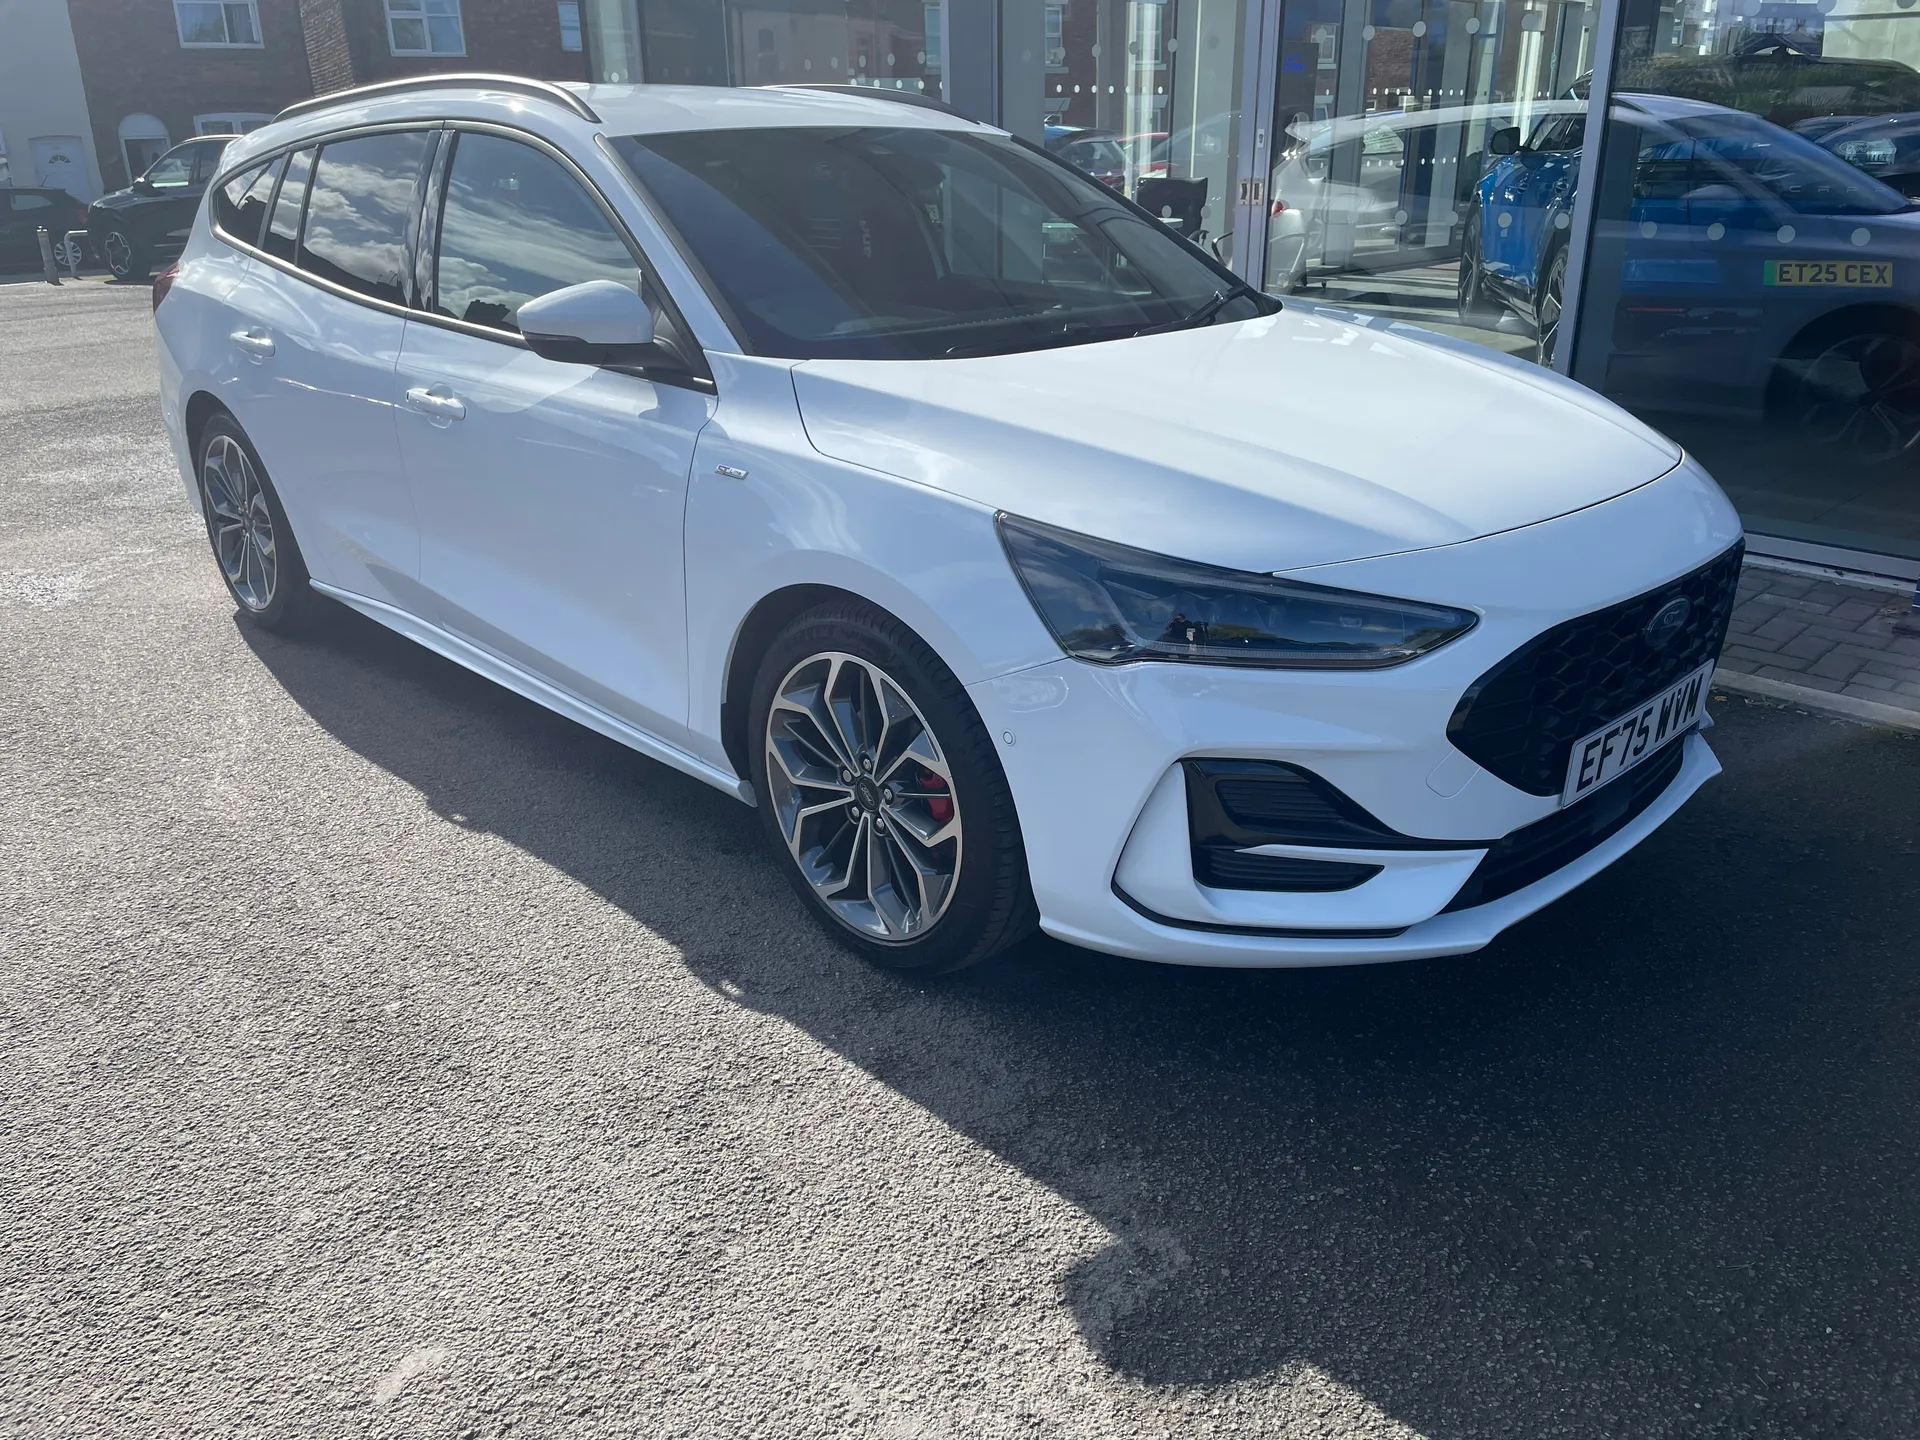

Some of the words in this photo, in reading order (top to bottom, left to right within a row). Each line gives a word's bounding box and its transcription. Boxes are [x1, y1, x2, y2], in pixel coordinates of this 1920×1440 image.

[1779, 263, 1837, 282] ET25
[1844, 265, 1888, 284] CEX
[1576, 706, 1654, 793] EF75
[1655, 673, 1704, 744] WVM
